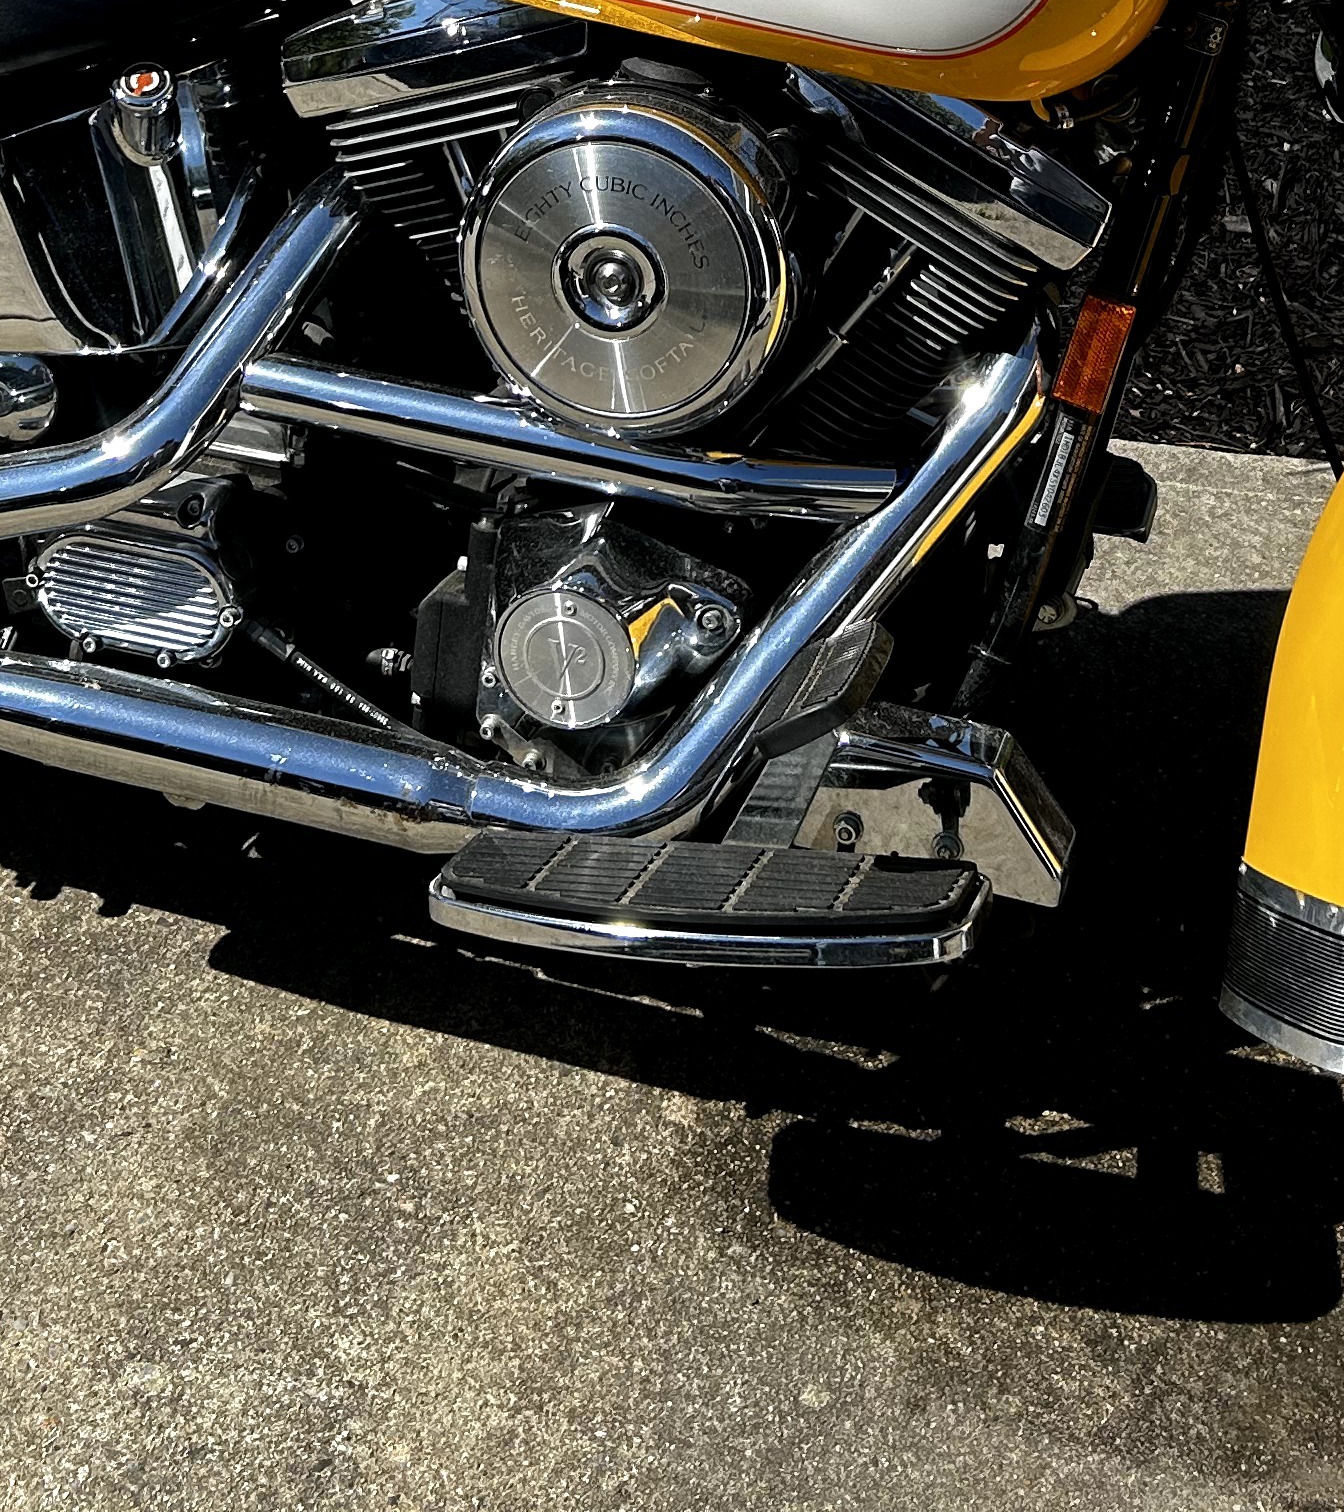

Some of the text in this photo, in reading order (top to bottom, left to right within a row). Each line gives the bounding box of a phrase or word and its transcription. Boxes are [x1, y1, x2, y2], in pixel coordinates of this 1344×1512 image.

[513, 175, 711, 270] EIGHTY CUBIC INCHES
[511, 295, 706, 383] HERITAGE OFTAIL
